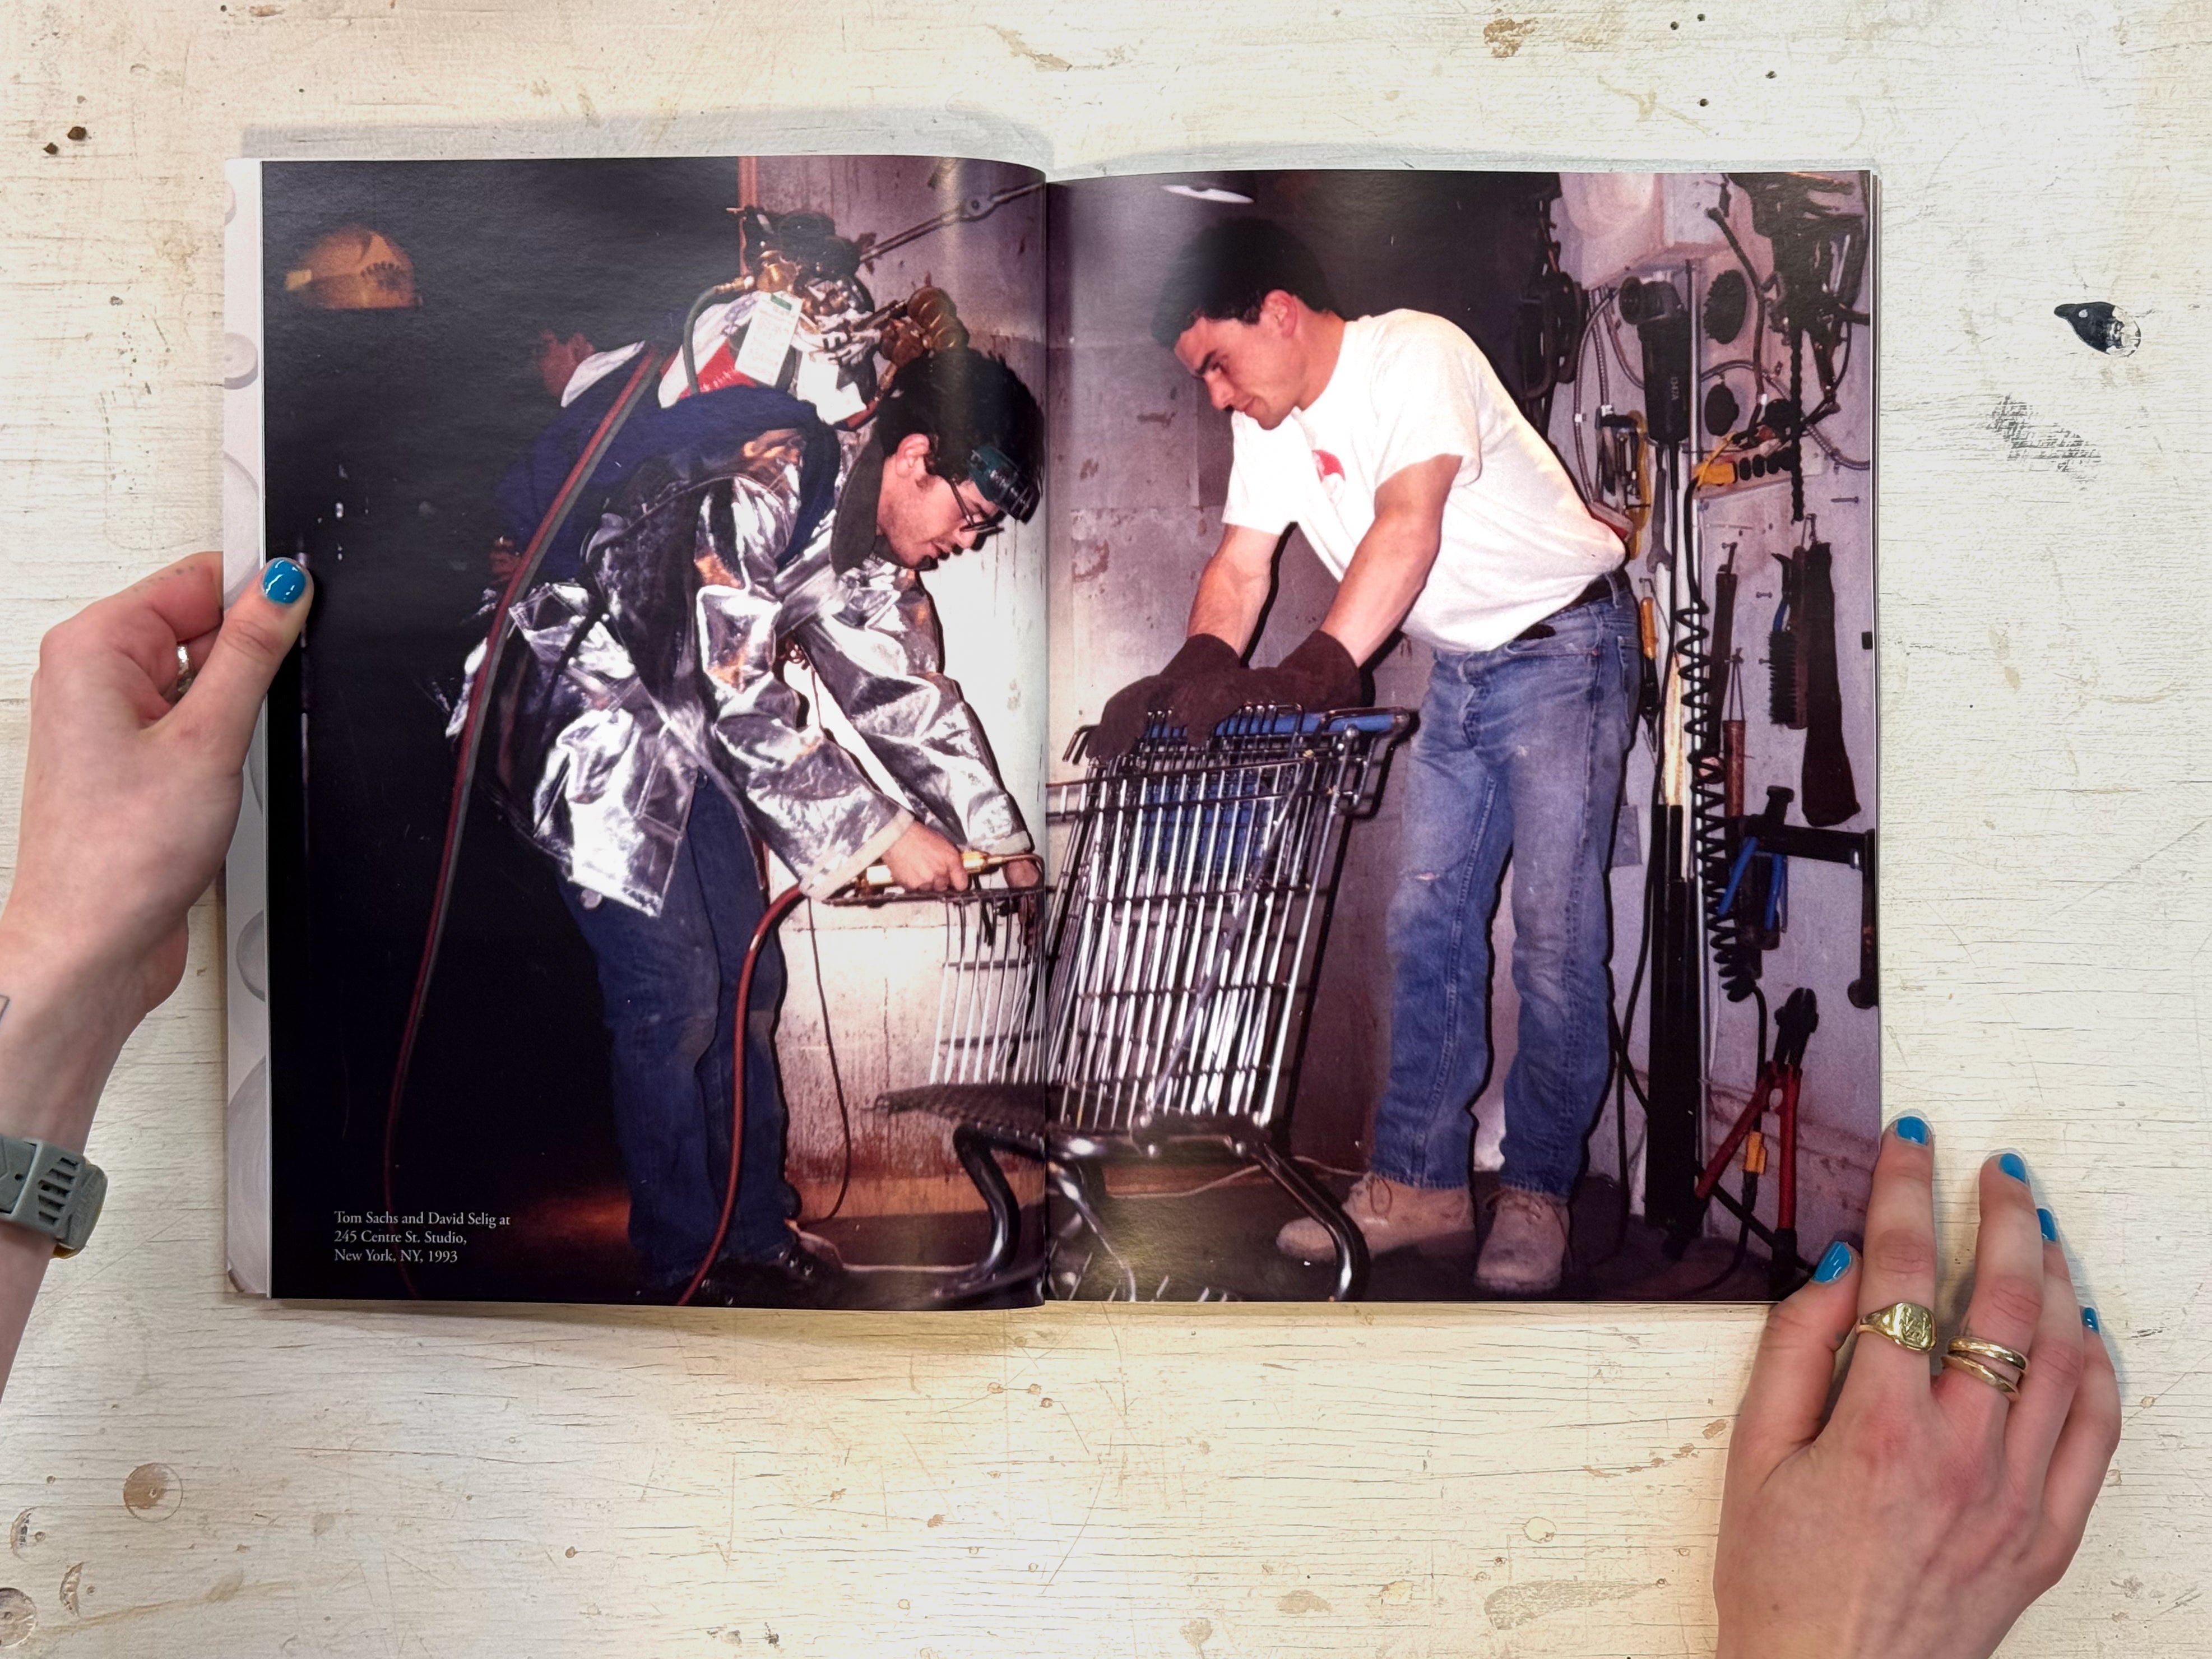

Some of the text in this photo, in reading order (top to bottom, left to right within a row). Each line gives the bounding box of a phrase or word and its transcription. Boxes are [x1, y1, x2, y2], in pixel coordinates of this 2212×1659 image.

[334, 1211, 511, 1229] Tom Sachs and David Selig at
[334, 1230, 467, 1245] 245 Centre St. Studio,
[335, 1249, 458, 1263] New York, NY, 1993
